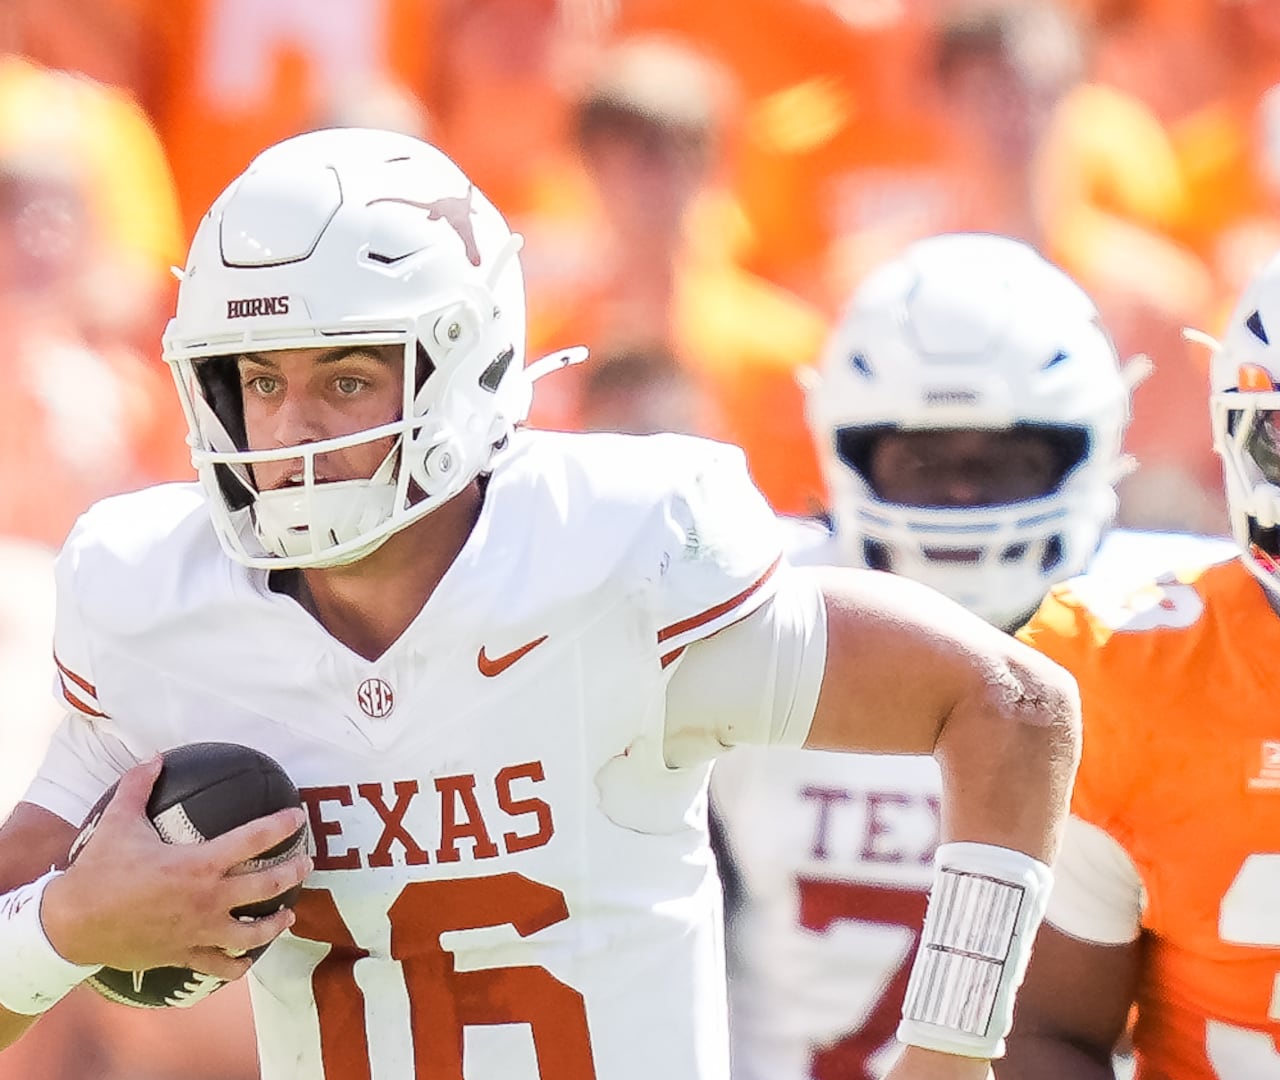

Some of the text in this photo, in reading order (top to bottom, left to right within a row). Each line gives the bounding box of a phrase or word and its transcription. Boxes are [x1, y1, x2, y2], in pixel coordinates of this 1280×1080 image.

[227, 296, 289, 319] HORNS
[357, 679, 394, 718] SEC
[299, 760, 555, 871] EXAS
